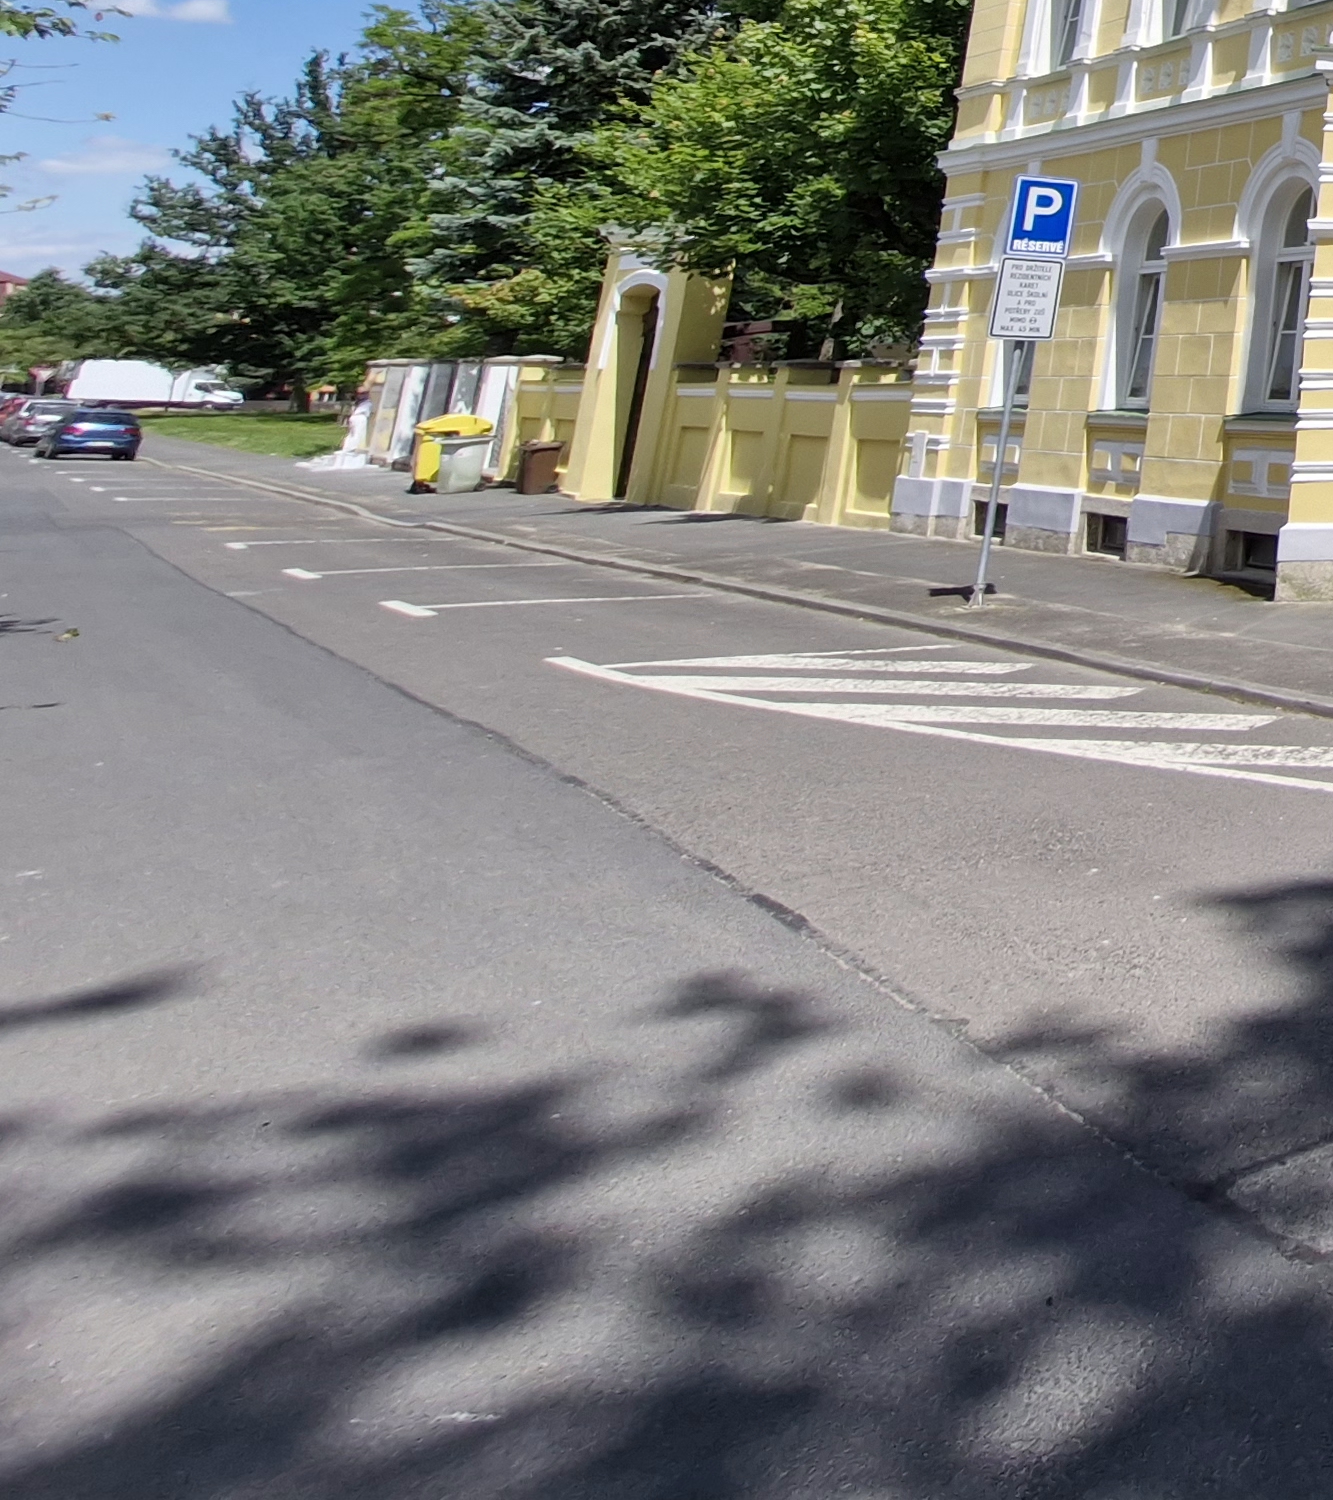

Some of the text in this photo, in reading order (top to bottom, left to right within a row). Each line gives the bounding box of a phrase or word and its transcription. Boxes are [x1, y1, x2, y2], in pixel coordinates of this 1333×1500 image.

[1023, 186, 1063, 231] P
[1013, 237, 1064, 253] RÉSERVÉ
[1026, 264, 1053, 272] DRŽITELE
[1026, 289, 1048, 298] ŠKOLNÍ
[1004, 306, 1031, 315] POTŘEBY
[1009, 316, 1026, 324] MIMO
